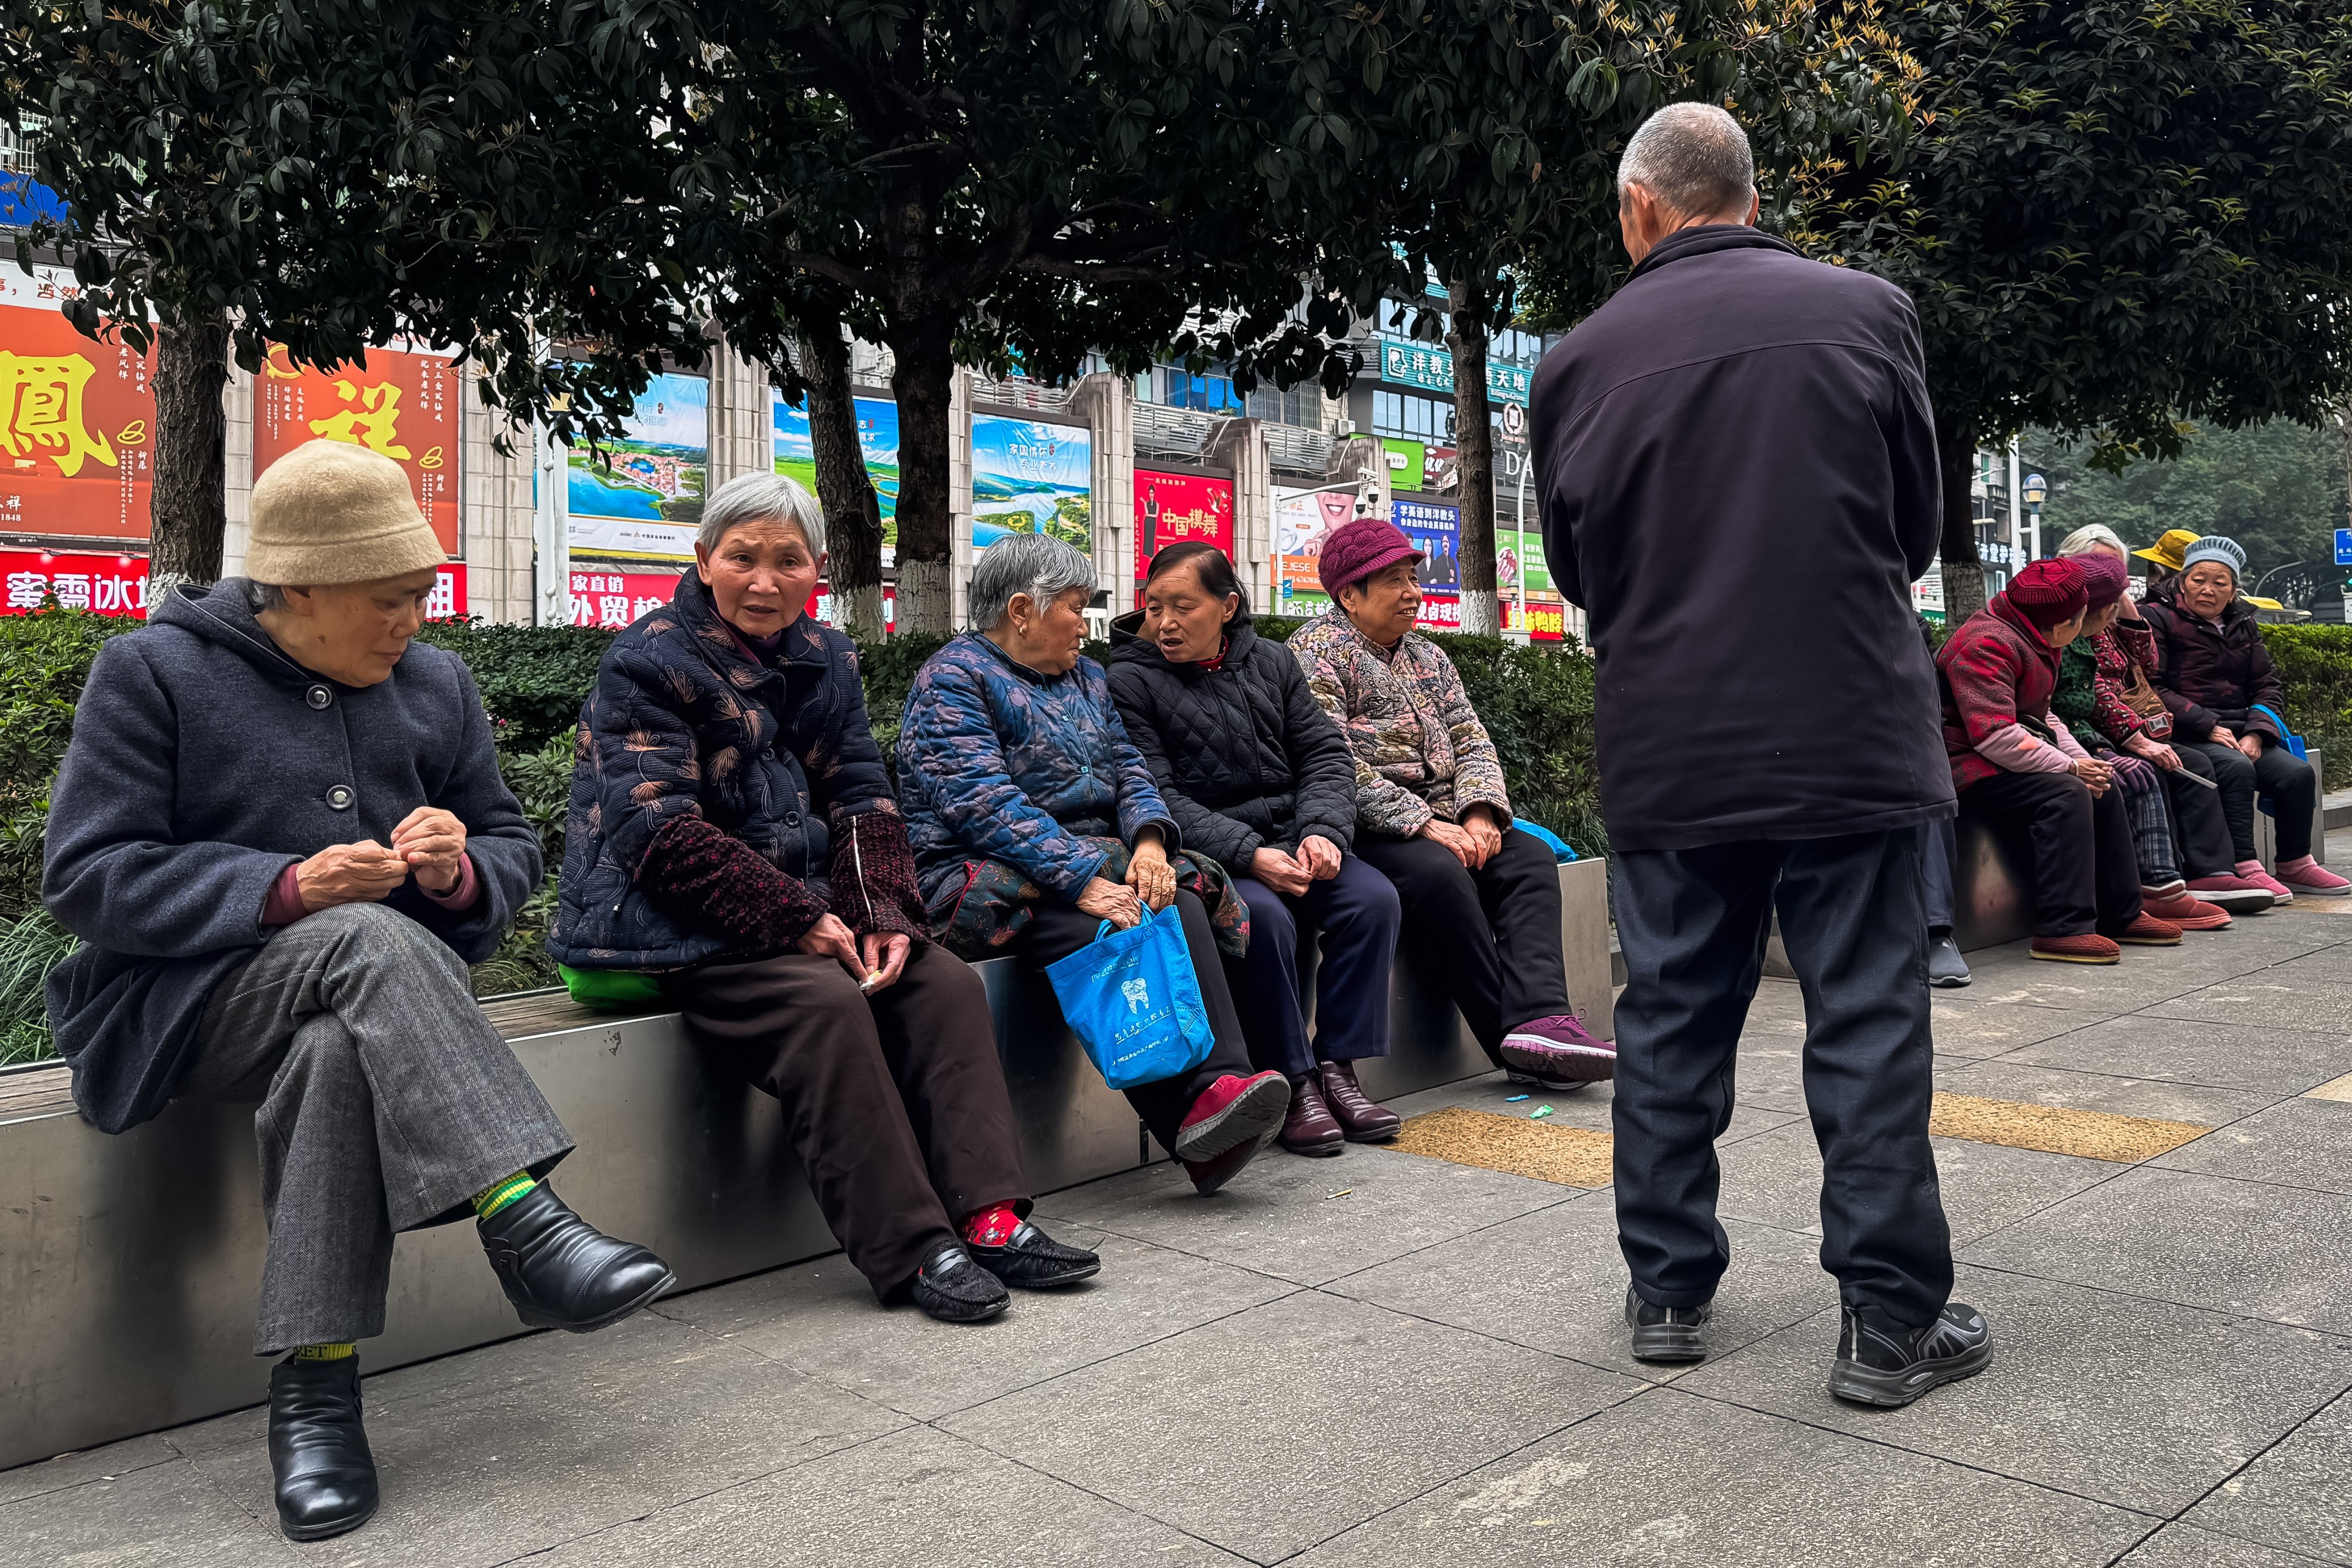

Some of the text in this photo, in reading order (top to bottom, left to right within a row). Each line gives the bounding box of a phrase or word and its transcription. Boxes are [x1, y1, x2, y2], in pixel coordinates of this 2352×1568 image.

[1400, 505, 1455, 521] 学英语到洋教头
[571, 574, 624, 593] 家直销
